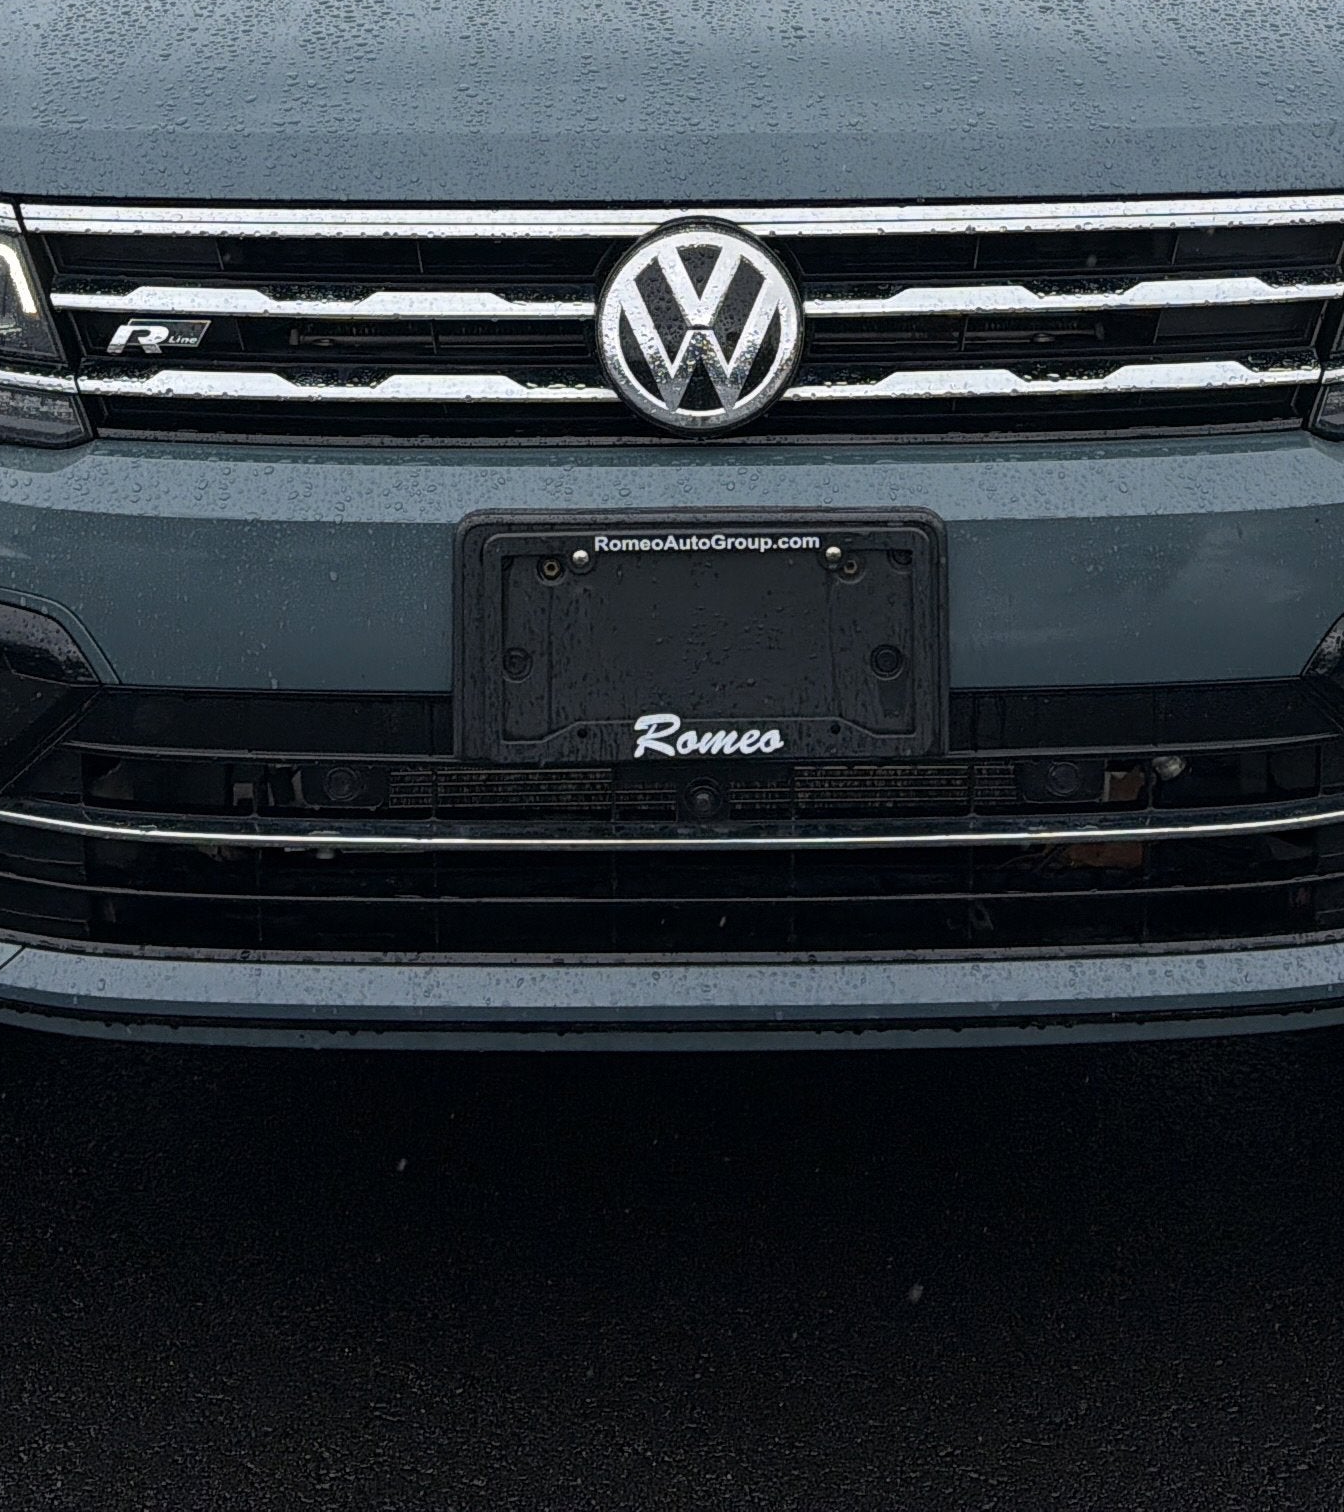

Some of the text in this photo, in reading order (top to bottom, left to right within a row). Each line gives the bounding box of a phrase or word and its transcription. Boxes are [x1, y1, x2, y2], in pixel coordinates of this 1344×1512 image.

[107, 325, 169, 354] R
[604, 232, 797, 428] VW
[594, 534, 820, 553] RomeoAutoGroup.com
[633, 713, 785, 758] Romeo
